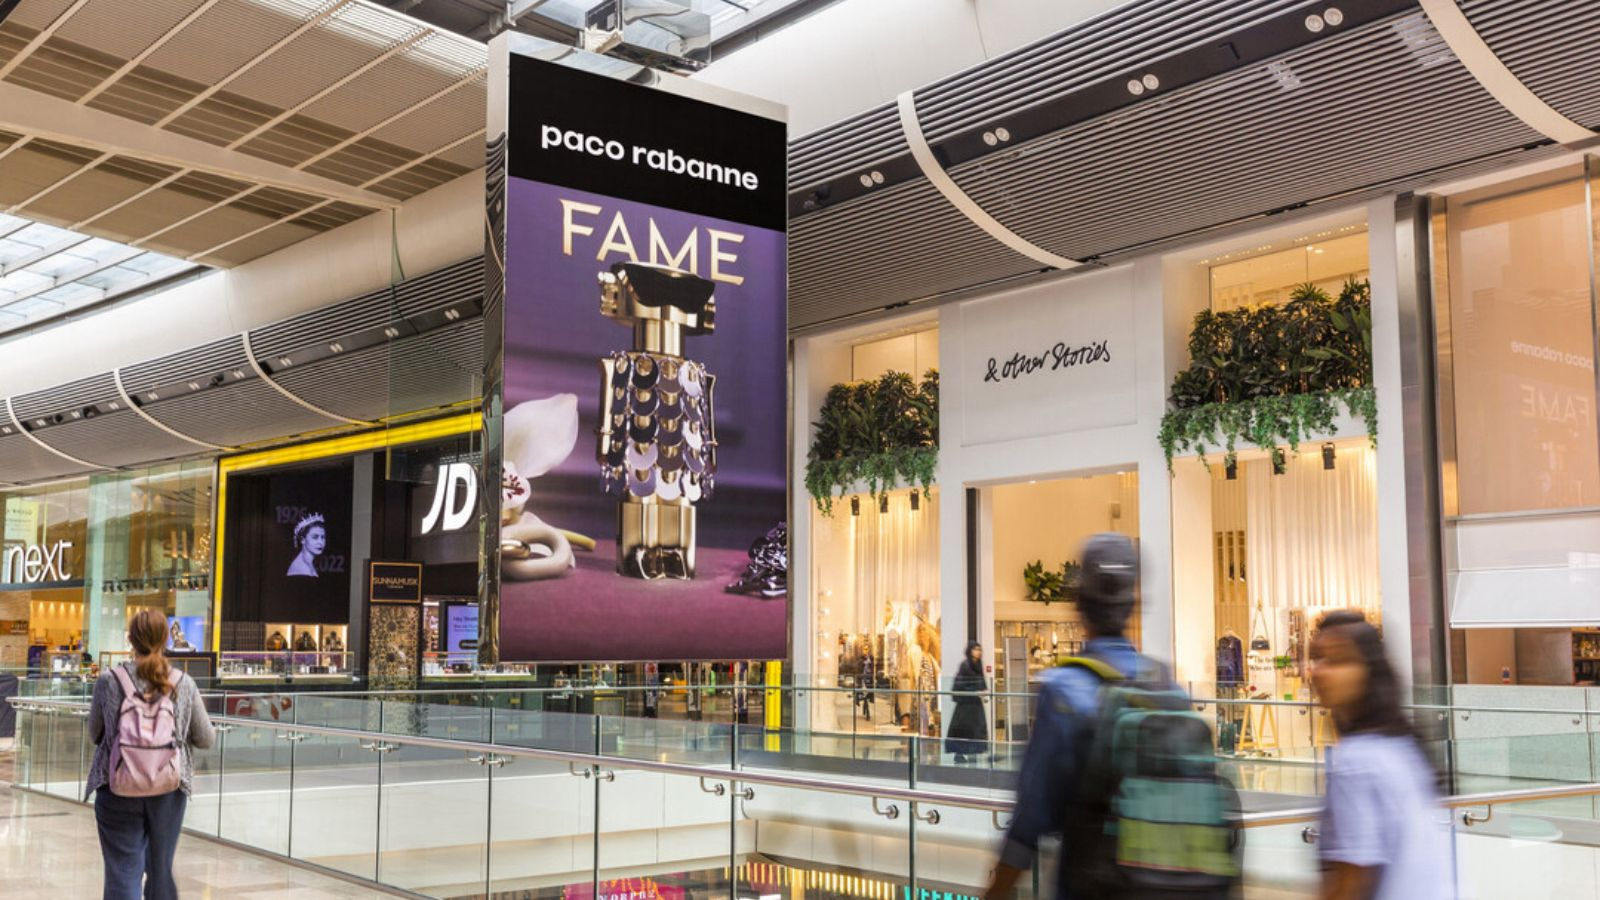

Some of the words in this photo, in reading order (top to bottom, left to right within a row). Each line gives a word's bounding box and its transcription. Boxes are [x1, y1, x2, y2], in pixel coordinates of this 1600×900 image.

[541, 124, 626, 161] paco
[632, 144, 759, 190] rabanne
[559, 198, 745, 286] FAME
[984, 357, 1001, 383] &
[1001, 350, 1050, 379] other
[1051, 340, 1111, 371] Stories
[421, 462, 478, 535] JD
[8, 539, 73, 584] next
[317, 554, 345, 573] 022
